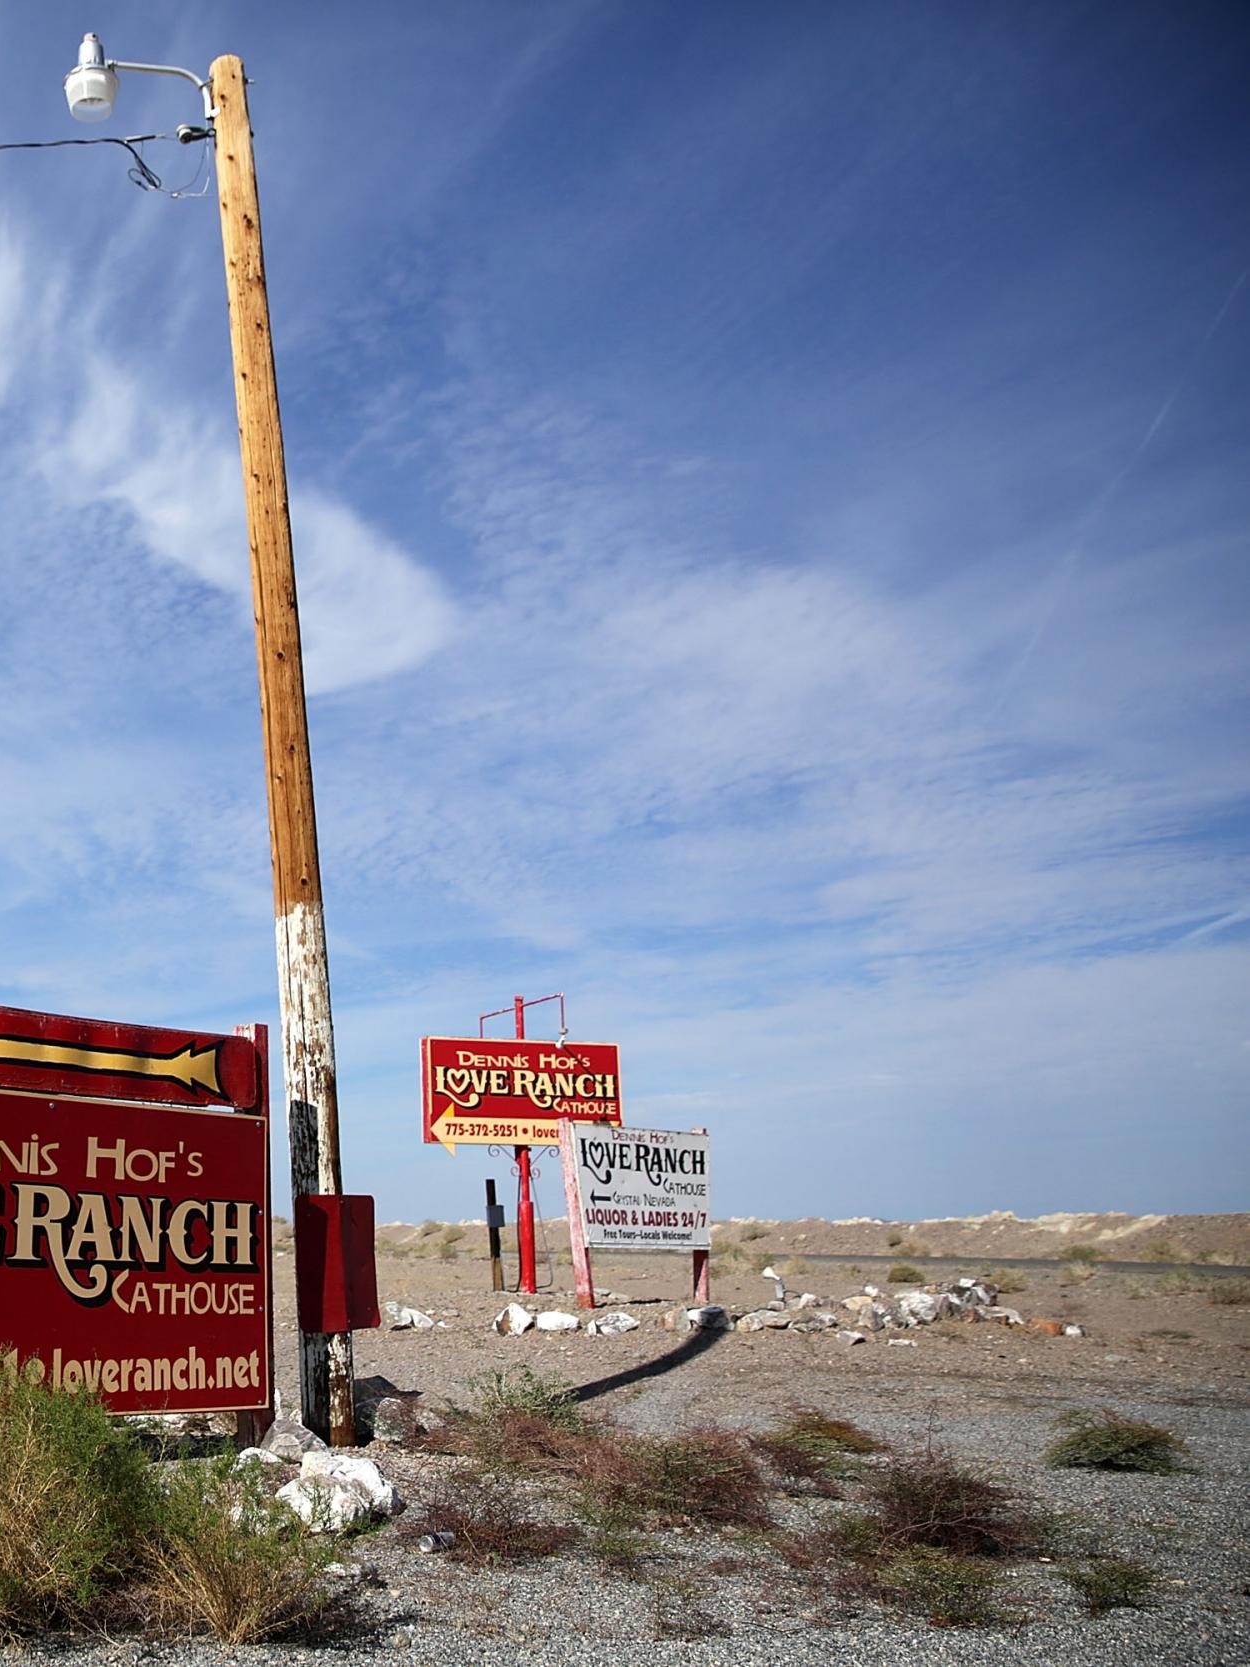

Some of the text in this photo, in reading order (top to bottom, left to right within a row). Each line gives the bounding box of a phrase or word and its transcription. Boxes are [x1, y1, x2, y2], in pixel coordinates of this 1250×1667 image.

[445, 1123, 518, 1138] 775-372-5251
[634, 1143, 705, 1187] RANCH
[663, 1177, 707, 1197] CATHOUSE
[585, 1208, 707, 1230] LIQUOR & LADIES 24/7
[13, 1183, 255, 1300] RANCH
[111, 1268, 255, 1316] CATHOUSE
[52, 1345, 260, 1395] loveranch.net
